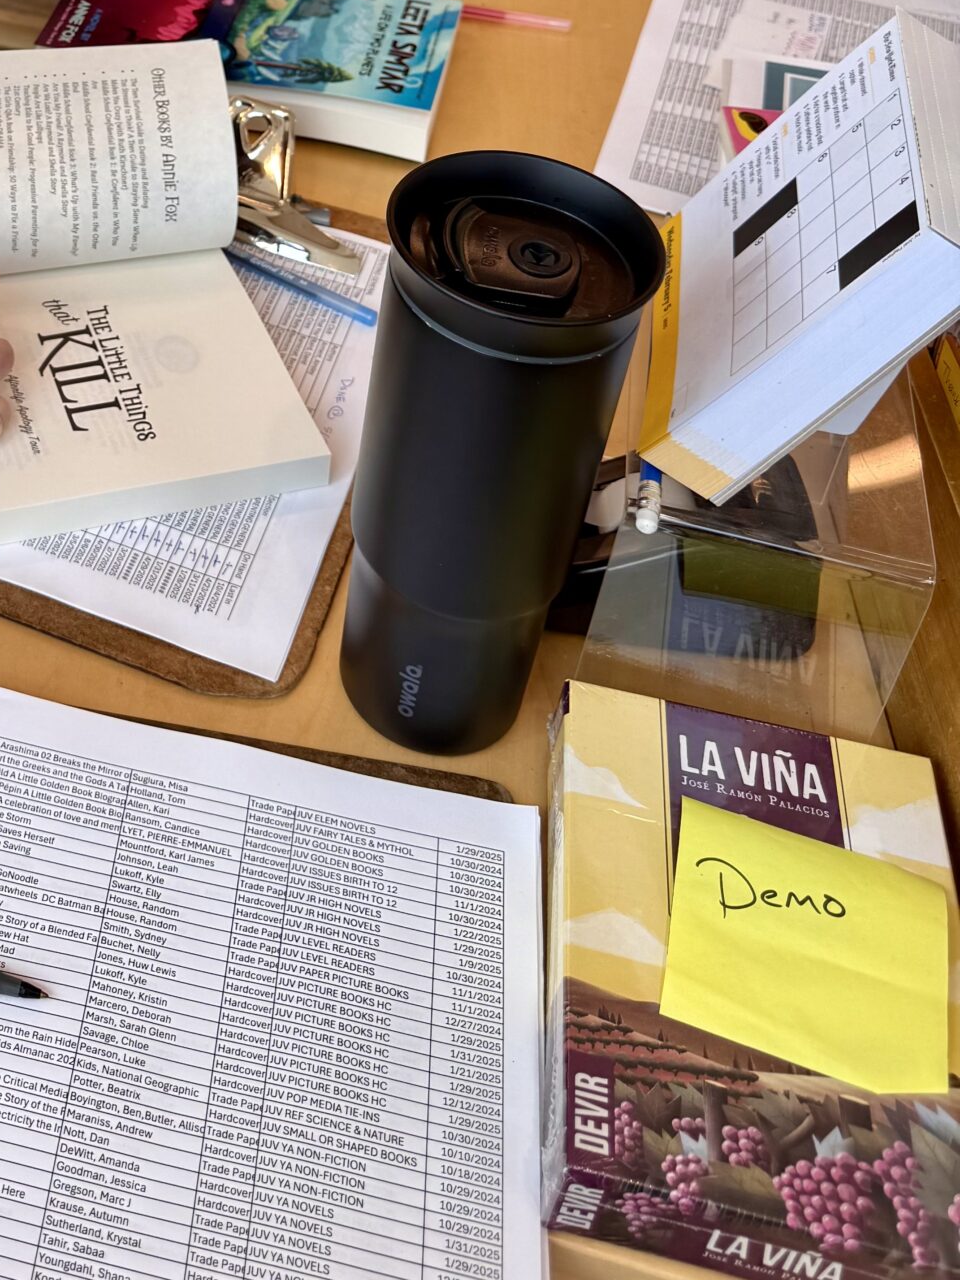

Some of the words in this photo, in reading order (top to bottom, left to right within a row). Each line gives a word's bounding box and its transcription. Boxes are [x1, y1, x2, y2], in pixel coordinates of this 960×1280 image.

[396, 0, 431, 36] LEETA
[376, 40, 417, 93] SIMTAR
[887, 93, 897, 103] 1
[851, 123, 862, 133] 5
[891, 119, 901, 130] 2
[160, 135, 173, 148] BY
[895, 146, 905, 157] 3
[817, 153, 828, 163] 6
[898, 176, 910, 186] 4
[164, 196, 180, 222] FOX
[753, 236, 764, 246] 9
[826, 265, 837, 275] 7
[41, 299, 80, 326] that
[37, 324, 122, 431] KILL
[29, 434, 41, 455] Tour
[398, 665, 424, 718] owala
[678, 733, 726, 782] LA
[735, 745, 828, 805] VIÑA
[1, 741, 40, 758] Arashima
[53, 754, 81, 768] Breaks
[132, 773, 166, 789] Sugiura,
[168, 781, 189, 792] Misa
[297, 810, 313, 821] JUV
[315, 814, 338, 827] ELEM
[340, 820, 376, 835] NOVELS
[456, 845, 502, 862] 1/29/2025
[22, 760, 51, 774] Greeks
[130, 786, 165, 801] Holland,
[168, 795, 186, 805] Tom
[249, 813, 294, 829] Hardcover
[313, 827, 338, 840] FAIRY
[340, 833, 367, 846] TALES
[377, 841, 414, 857] MYTHOL
[2, 811, 32, 826] Storm
[119, 839, 167, 858] Mountford,
[4, 798, 54, 815] celebration
[122, 825, 145, 839] LYET,
[147, 831, 232, 857] PIERRE-EMMANUEL
[125, 812, 162, 828] Ransom,
[164, 821, 200, 836] Candice
[2, 840, 31, 856] Saving
[24, 831, 55, 845] Herself
[117, 852, 155, 868] Johnson,
[312, 840, 350, 856] GOLDEN
[352, 849, 385, 864] BOOKS
[695, 856, 847, 920] Demo
[302, 935, 331, 951] LEVEL
[332, 942, 376, 961] READERS
[458, 958, 501, 975] 1/9/2025
[299, 965, 330, 982] PAPER
[332, 973, 373, 991] PICTURE
[445, 1016, 501, 1035] 12/27/2024
[13, 1042, 56, 1062] Almanac
[573, 1069, 611, 1157] DEVIR
[305, 1112, 352, 1133] SCIENCE
[363, 1127, 405, 1146] NATURE
[297, 1145, 367, 1172] NON-FICTION
[557, 1181, 604, 1231] DEVIR
[706, 1229, 749, 1259] LA
[762, 1243, 843, 1280] VIÑA
